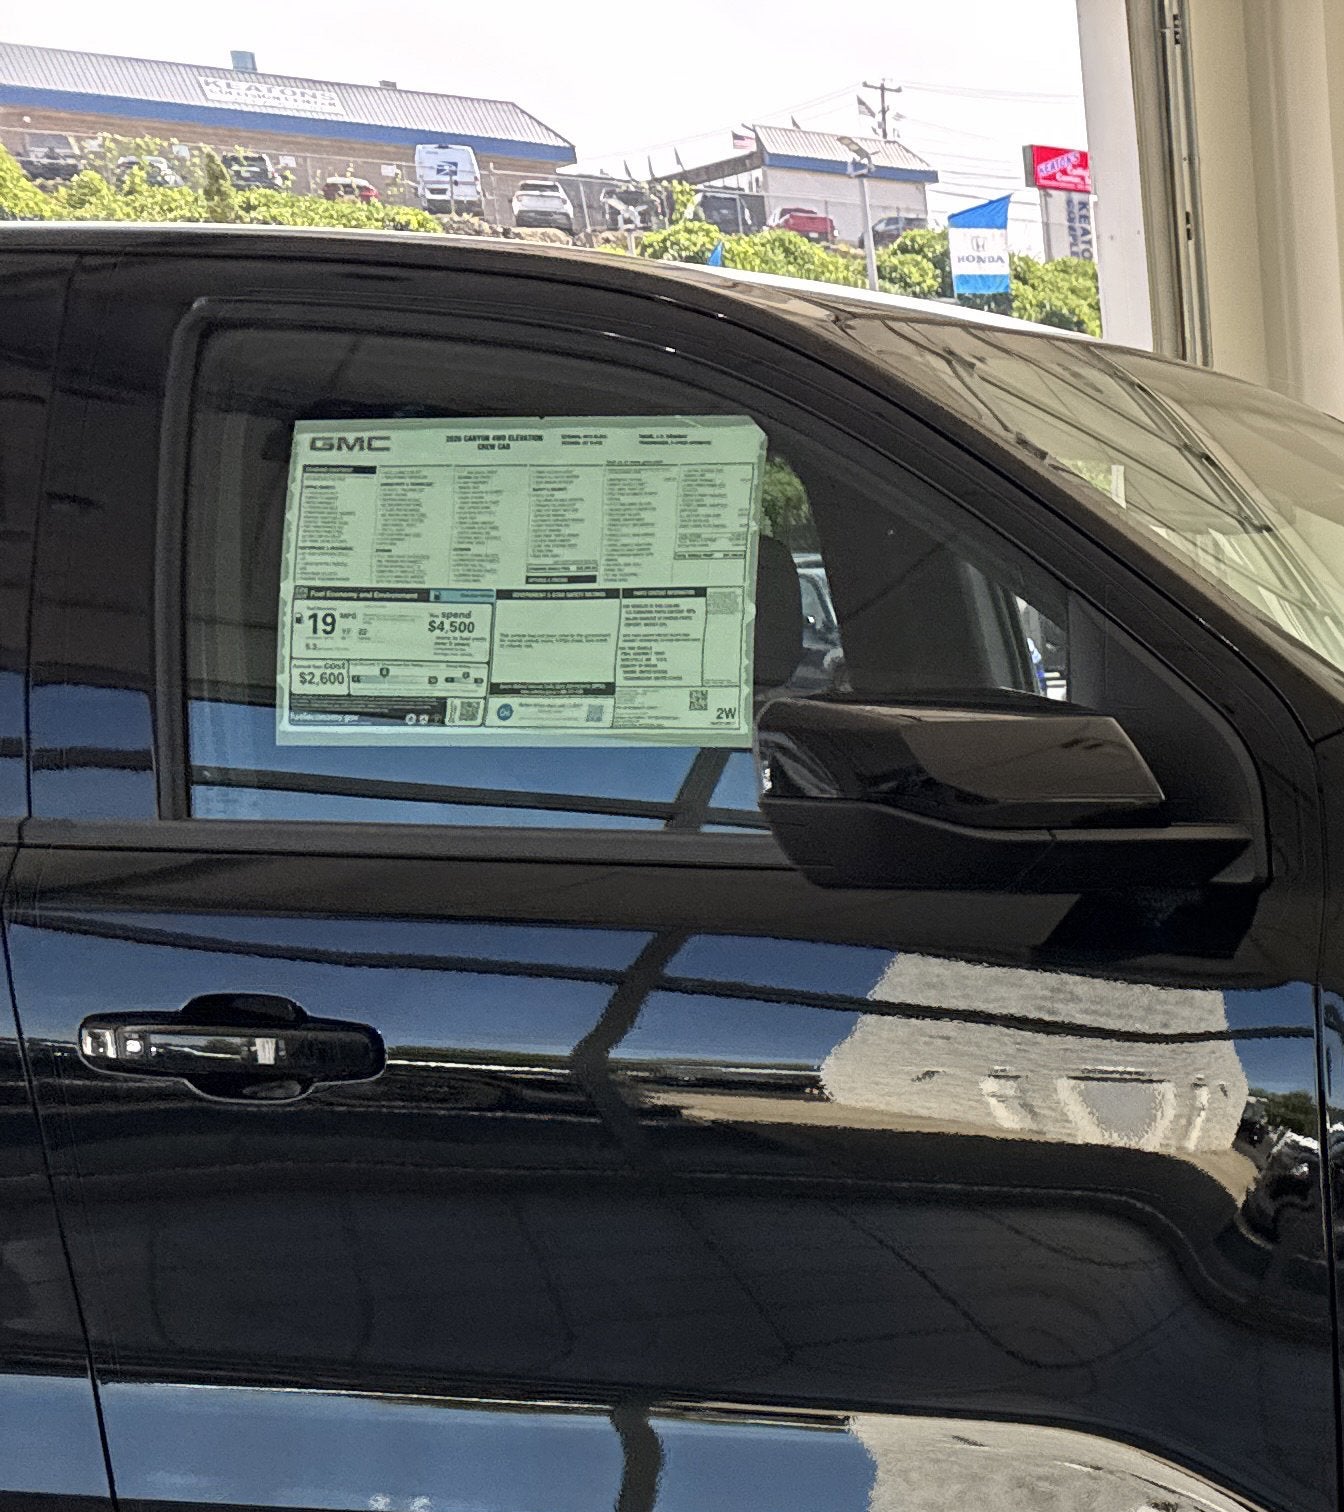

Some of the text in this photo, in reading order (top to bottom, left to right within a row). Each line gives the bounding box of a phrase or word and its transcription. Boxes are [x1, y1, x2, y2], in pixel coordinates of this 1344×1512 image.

[957, 255, 1005, 264] HONDA
[309, 436, 391, 451] GMC
[308, 612, 337, 635] 19
[427, 620, 475, 634] $4,500
[299, 671, 345, 686] $2,600
[716, 707, 737, 720] 2W
